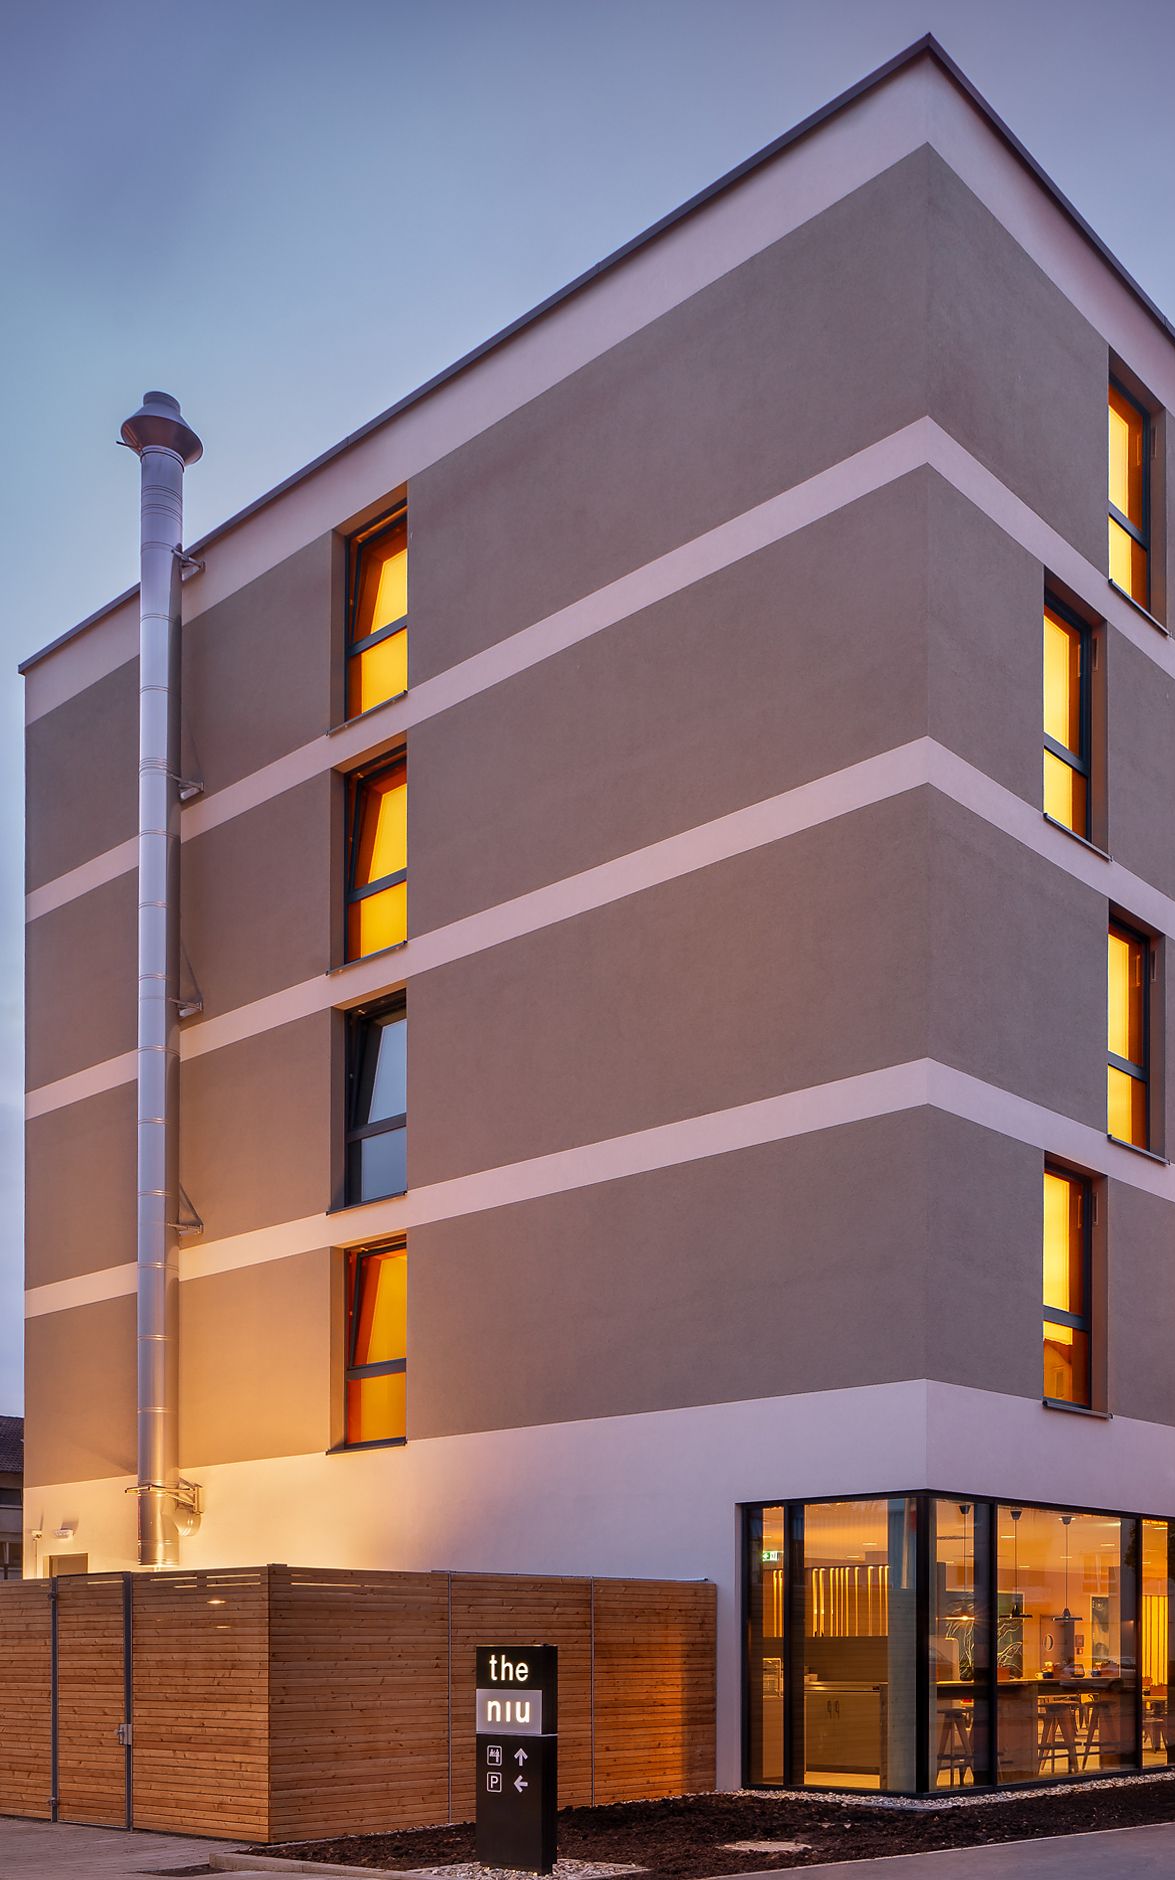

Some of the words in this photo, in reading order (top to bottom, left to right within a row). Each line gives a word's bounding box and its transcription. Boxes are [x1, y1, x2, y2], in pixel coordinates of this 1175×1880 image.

[489, 1654, 529, 1682] the
[487, 1700, 530, 1723] niu
[490, 1775, 499, 1789] P
